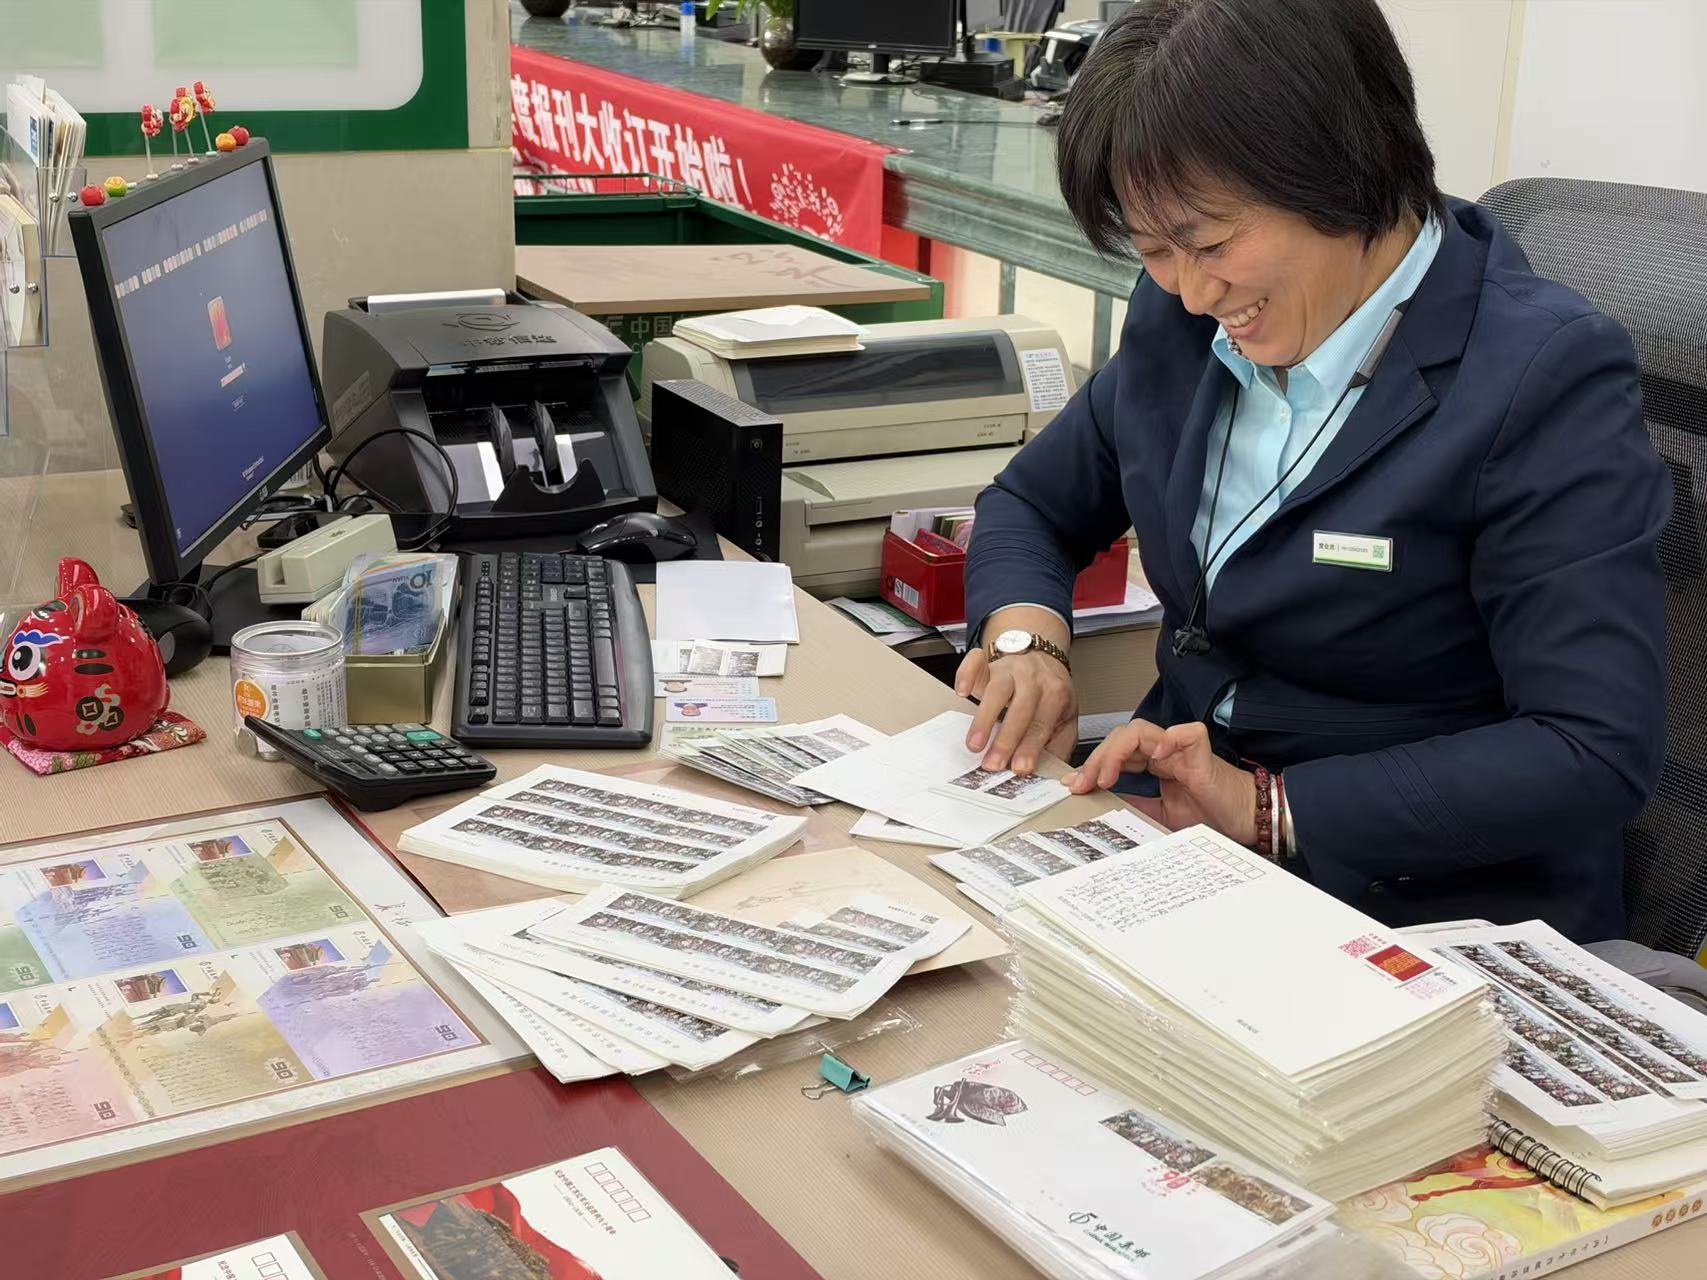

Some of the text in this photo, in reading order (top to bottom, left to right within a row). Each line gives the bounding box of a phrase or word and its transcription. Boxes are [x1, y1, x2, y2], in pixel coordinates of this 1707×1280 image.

[510, 74, 753, 211] 度报刊大收订开始啦！
[409, 569, 433, 590] 10
